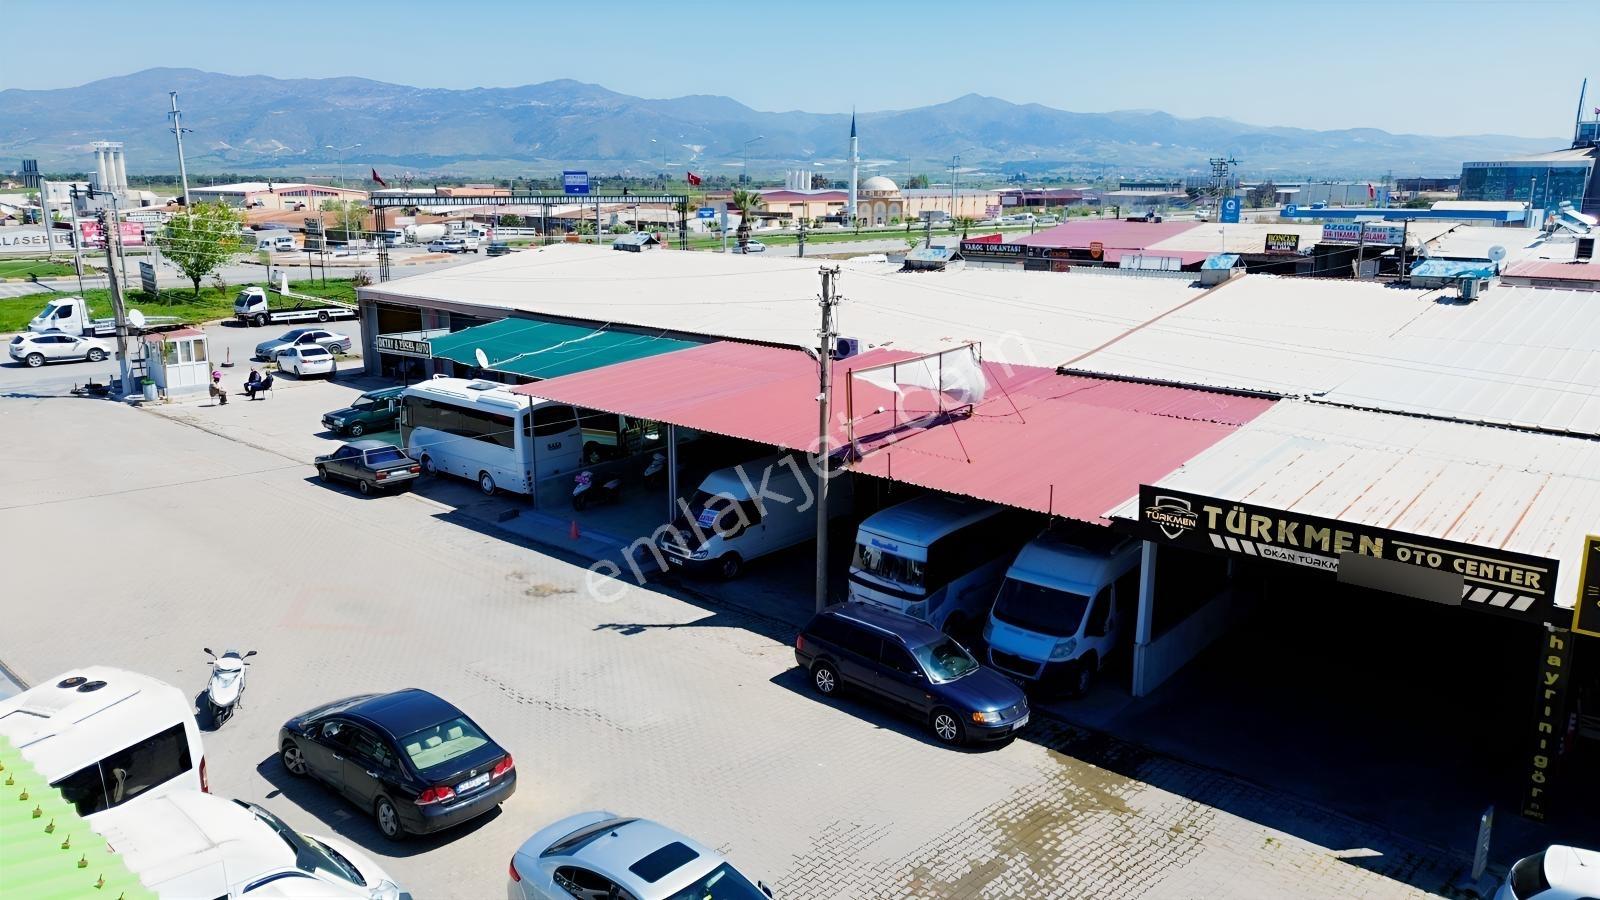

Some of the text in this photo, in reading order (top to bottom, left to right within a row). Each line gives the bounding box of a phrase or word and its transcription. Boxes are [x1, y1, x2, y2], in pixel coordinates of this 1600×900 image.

[1145, 509, 1196, 527] TÜRKMEN
[1203, 505, 1541, 589] TÜRKMEN OTO CENTER
[1263, 548, 1338, 571] OKAN TÜRKM
